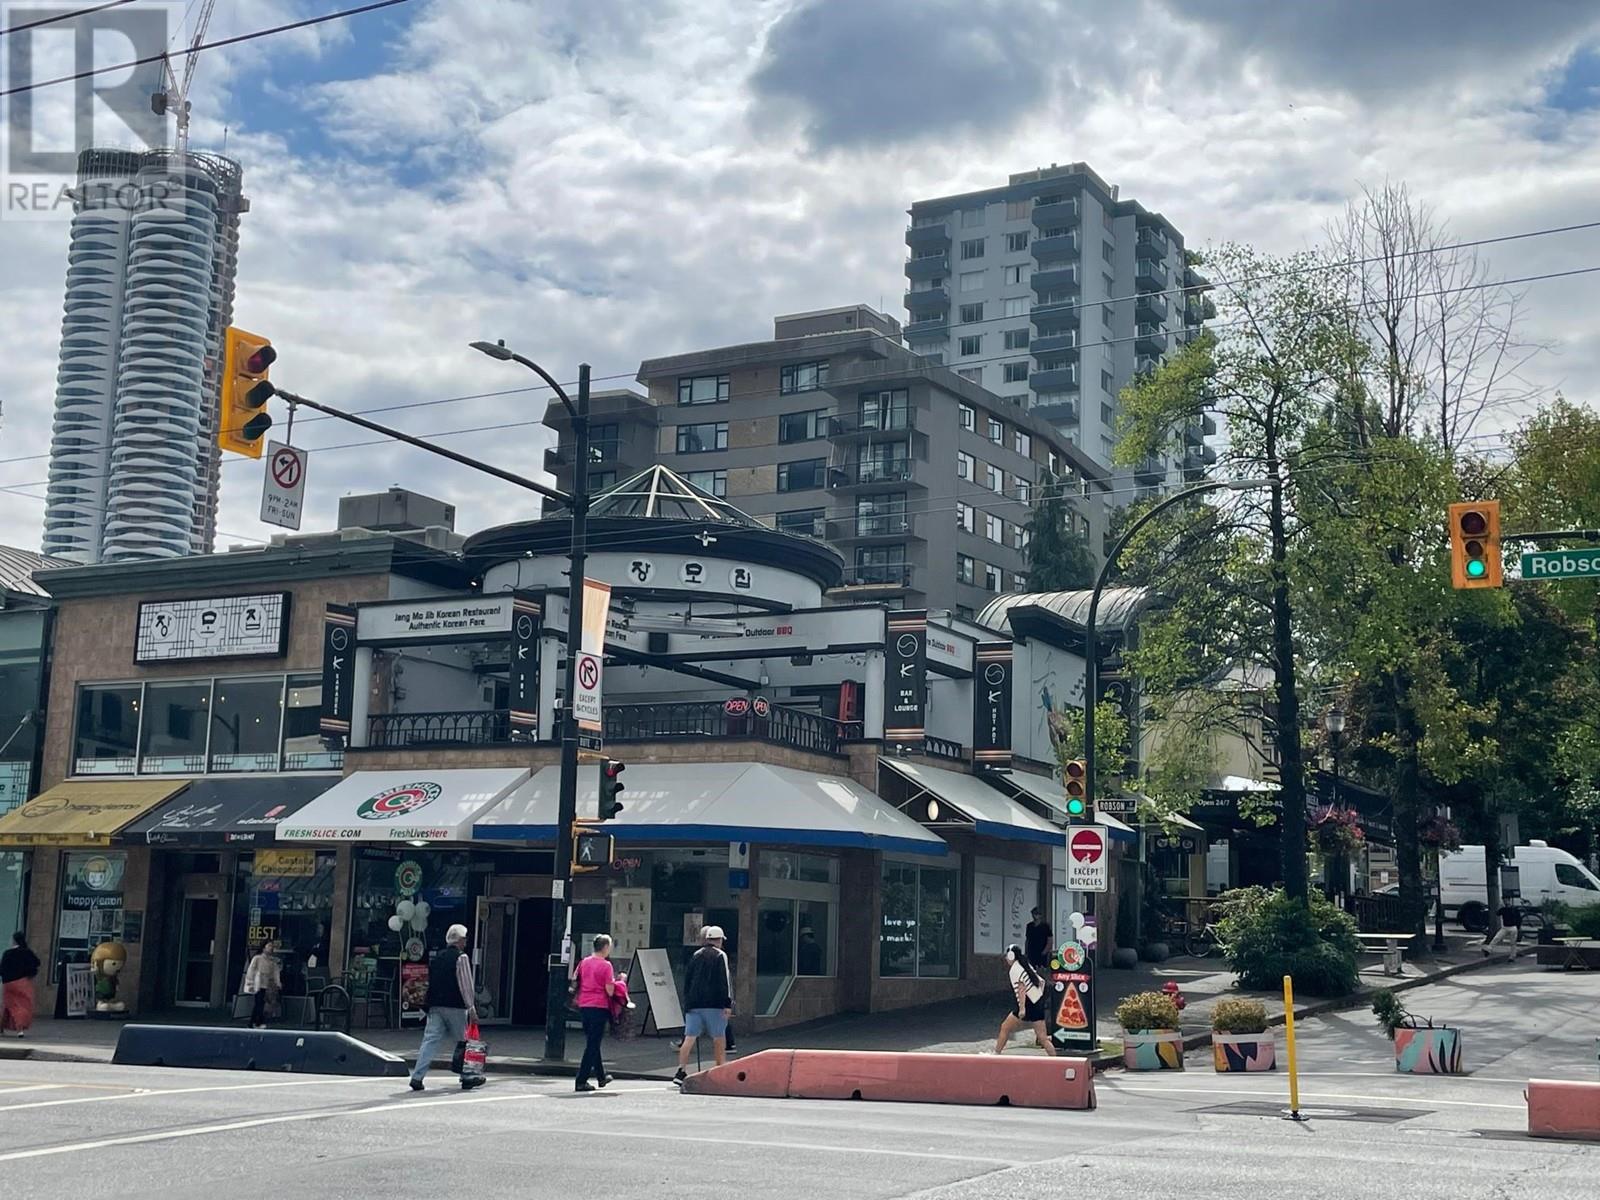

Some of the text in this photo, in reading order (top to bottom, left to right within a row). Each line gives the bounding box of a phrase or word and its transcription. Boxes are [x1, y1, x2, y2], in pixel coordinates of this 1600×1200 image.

[436, 609, 461, 618] Korean
[463, 606, 501, 617] Restaurant
[408, 618, 485, 630] Authentic Korean Fare
[745, 627, 774, 637] Outdoor
[776, 626, 793, 635] BBQ
[518, 644, 529, 660] K
[332, 655, 344, 670] K
[899, 663, 915, 678] K
[900, 689, 913, 697] BAR
[987, 690, 1002, 704] K
[726, 700, 748, 711] OPEN
[893, 704, 919, 712] LOUNGE
[1099, 800, 1126, 811] ROBSON
[389, 828, 448, 838] FreshLivesHere
[1073, 867, 1099, 876] EXCEPT
[1070, 878, 1103, 887] BICYCLES
[884, 915, 902, 926] love
[249, 926, 277, 940] BEST
